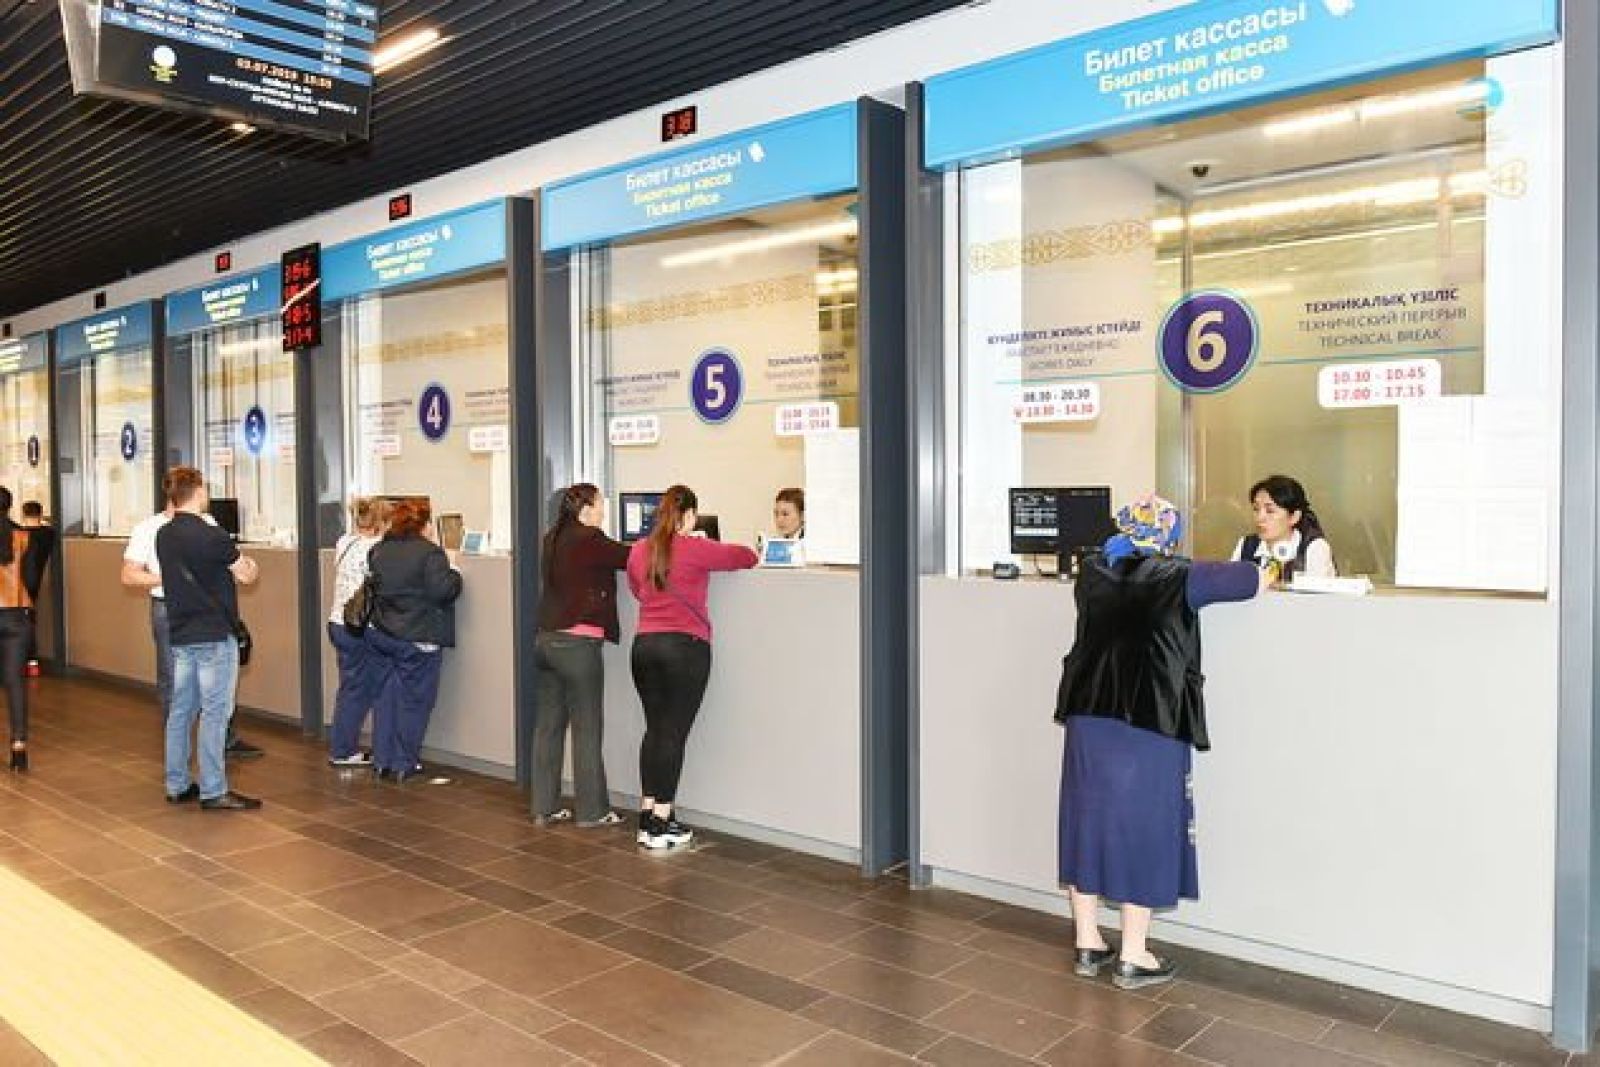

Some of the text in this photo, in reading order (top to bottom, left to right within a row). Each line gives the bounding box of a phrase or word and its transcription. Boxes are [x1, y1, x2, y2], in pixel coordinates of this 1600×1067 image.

[1084, 5, 1306, 76] Билет кассасы
[1099, 34, 1289, 92] Билетная касса
[1121, 64, 1265, 109] Ticket office
[1298, 308, 1467, 332] ТЕХНИЧЕСКИЙ ПЕРЕРЫВ
[1304, 292, 1406, 314] ТЕХНИКАЛЫҚ
[1187, 310, 1227, 373] 6
[1320, 329, 1442, 348] TECHNICAL BREAK
[704, 363, 727, 408] 5
[1385, 366, 1426, 382] 10.45
[1333, 387, 1371, 401] 17.00
[1384, 385, 1426, 399] 17.15
[427, 394, 442, 430] 4
